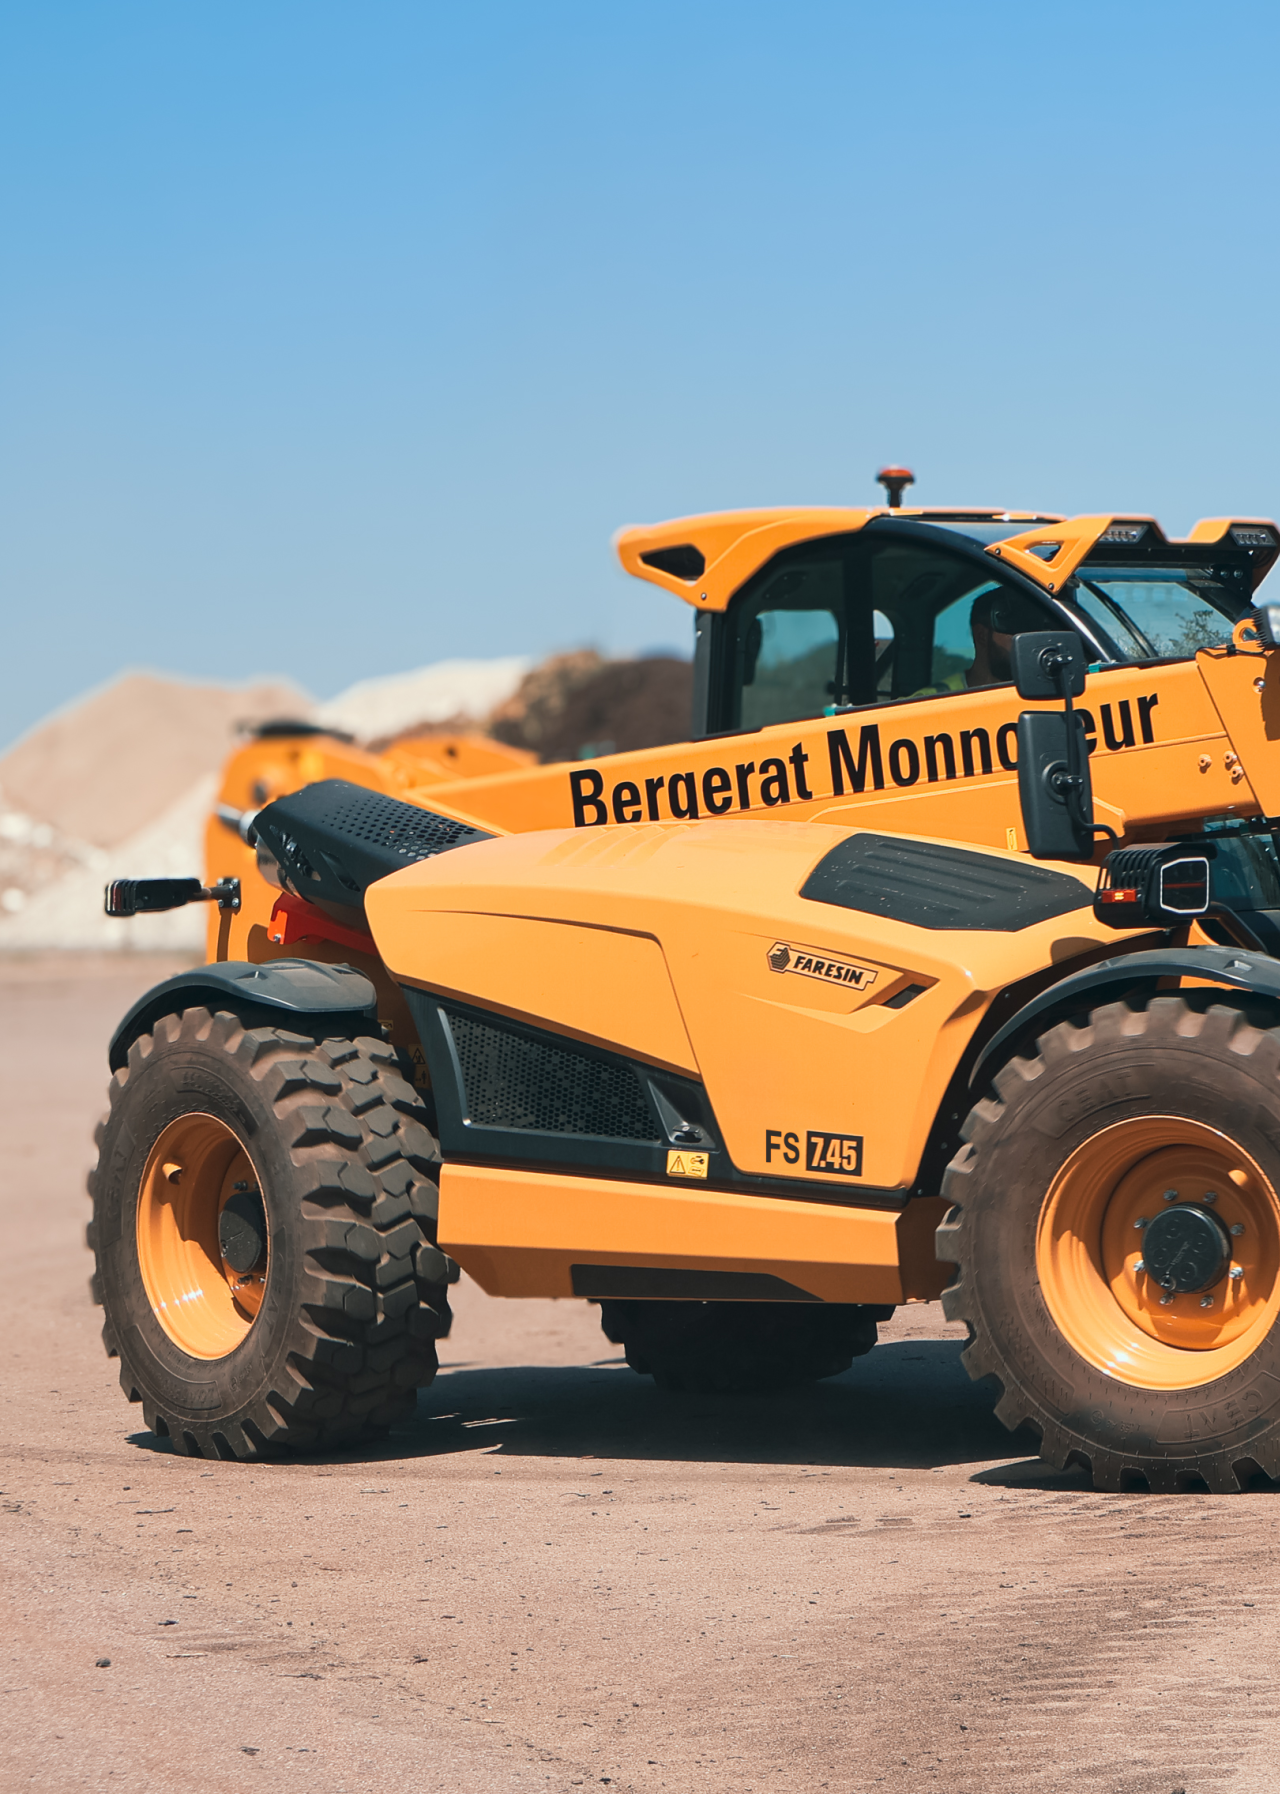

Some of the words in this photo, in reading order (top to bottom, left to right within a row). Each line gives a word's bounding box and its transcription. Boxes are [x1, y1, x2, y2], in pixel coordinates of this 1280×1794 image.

[569, 741, 813, 828] Bergerat
[827, 693, 1159, 797] Monnour
[793, 955, 864, 985] FARESIN
[1056, 1070, 1133, 1122] CEAT
[766, 1129, 800, 1164] FS
[810, 1136, 858, 1171] 7.45
[1183, 1388, 1264, 1439] CEAT
